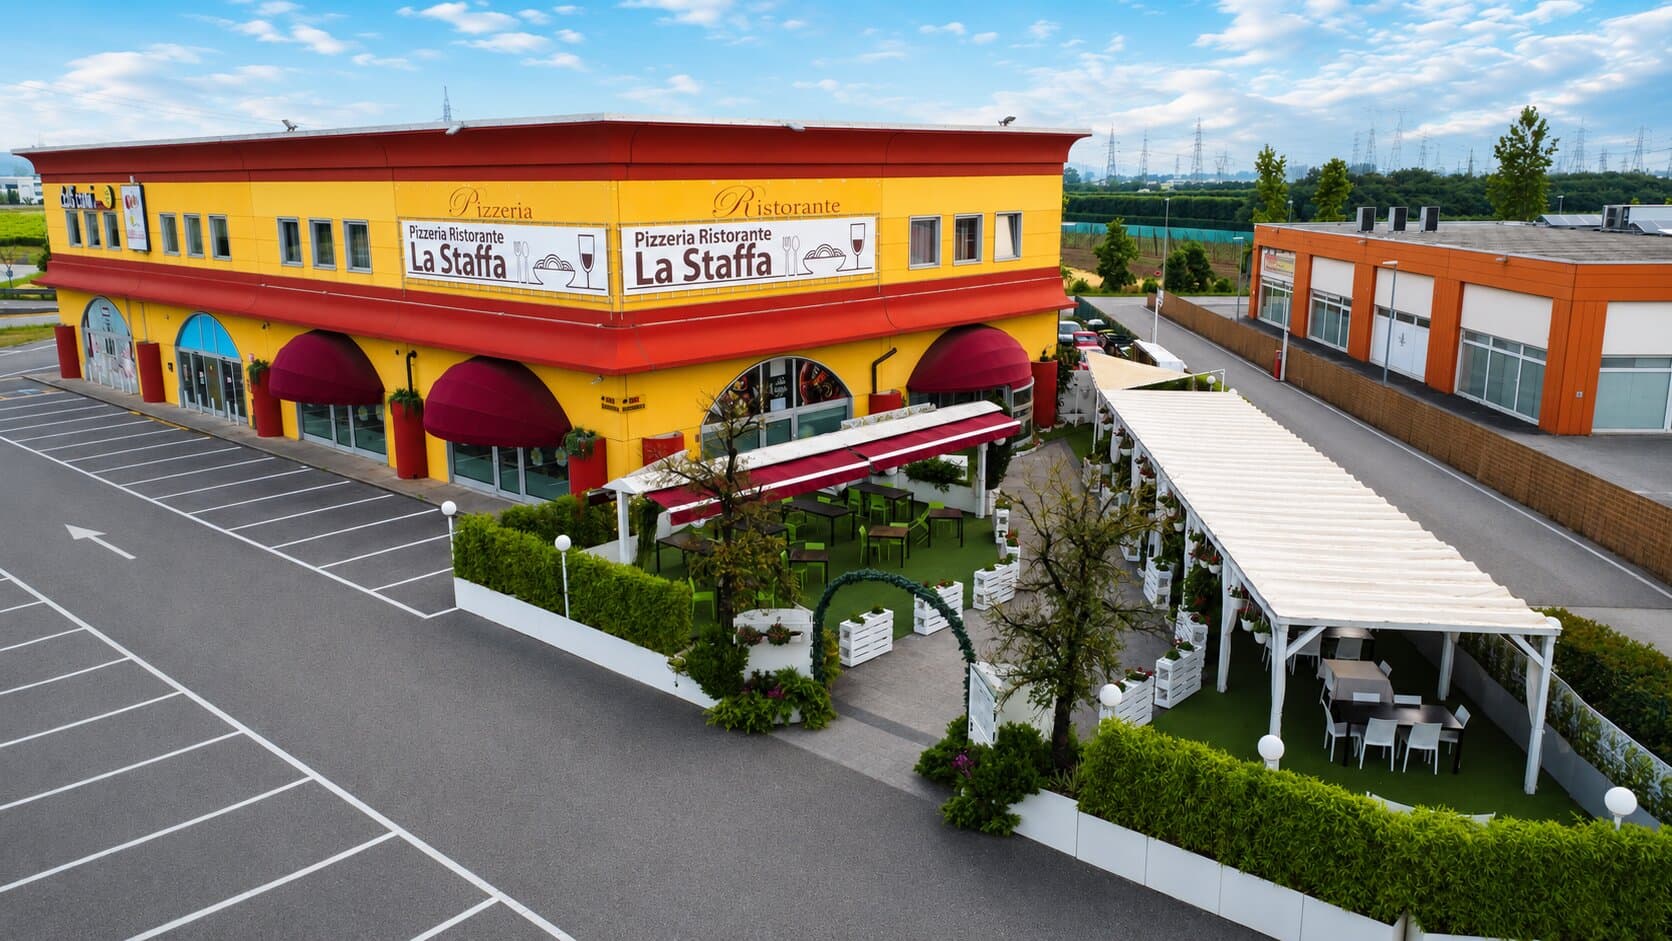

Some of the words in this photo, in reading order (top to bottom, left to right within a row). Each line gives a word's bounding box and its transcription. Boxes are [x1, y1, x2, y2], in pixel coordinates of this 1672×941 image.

[449, 187, 533, 219] Pizzeria
[712, 185, 840, 217] Ristorante
[409, 225, 447, 241] Pizzeria
[449, 227, 504, 244] Ristorante
[635, 230, 695, 248] Pizzeria
[700, 227, 772, 245] Ristorante
[410, 242, 435, 273] La
[440, 243, 507, 279] Staffa
[635, 251, 673, 286] La
[683, 243, 772, 282] Staffa
